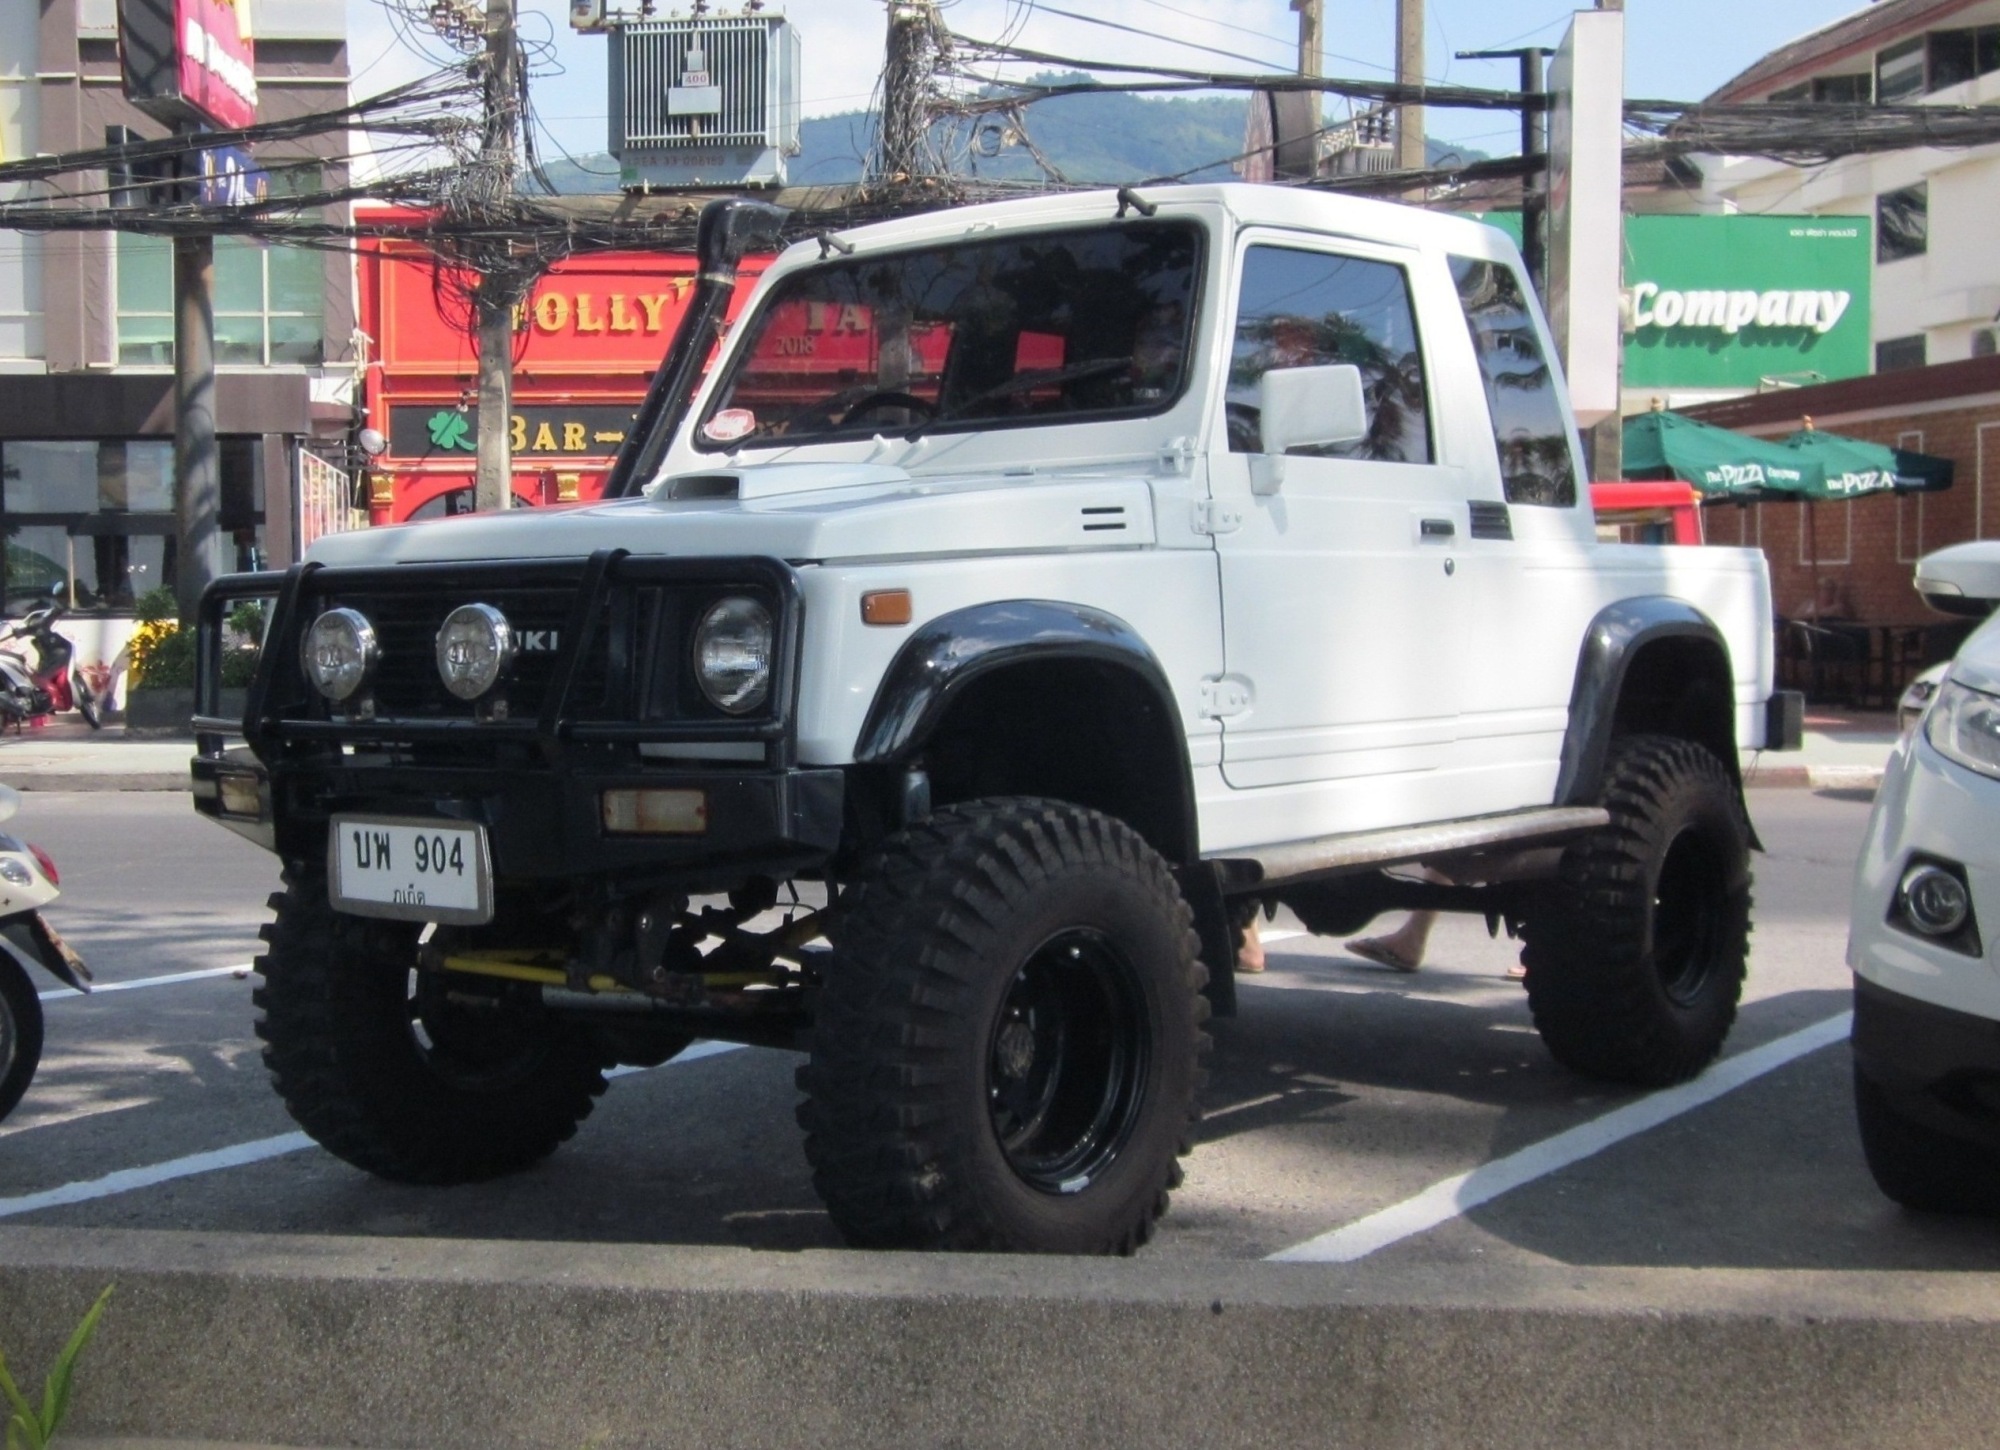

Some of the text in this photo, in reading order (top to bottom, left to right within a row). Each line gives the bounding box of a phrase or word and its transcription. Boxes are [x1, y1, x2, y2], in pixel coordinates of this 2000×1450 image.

[685, 74, 708, 85] 400
[512, 277, 695, 331] OLLY'
[1633, 281, 1850, 334] Company
[775, 336, 817, 355] 2018
[1718, 463, 1767, 487] PIZZA
[1841, 470, 1894, 493] PIZZA
[353, 830, 464, 876] บพ 904
